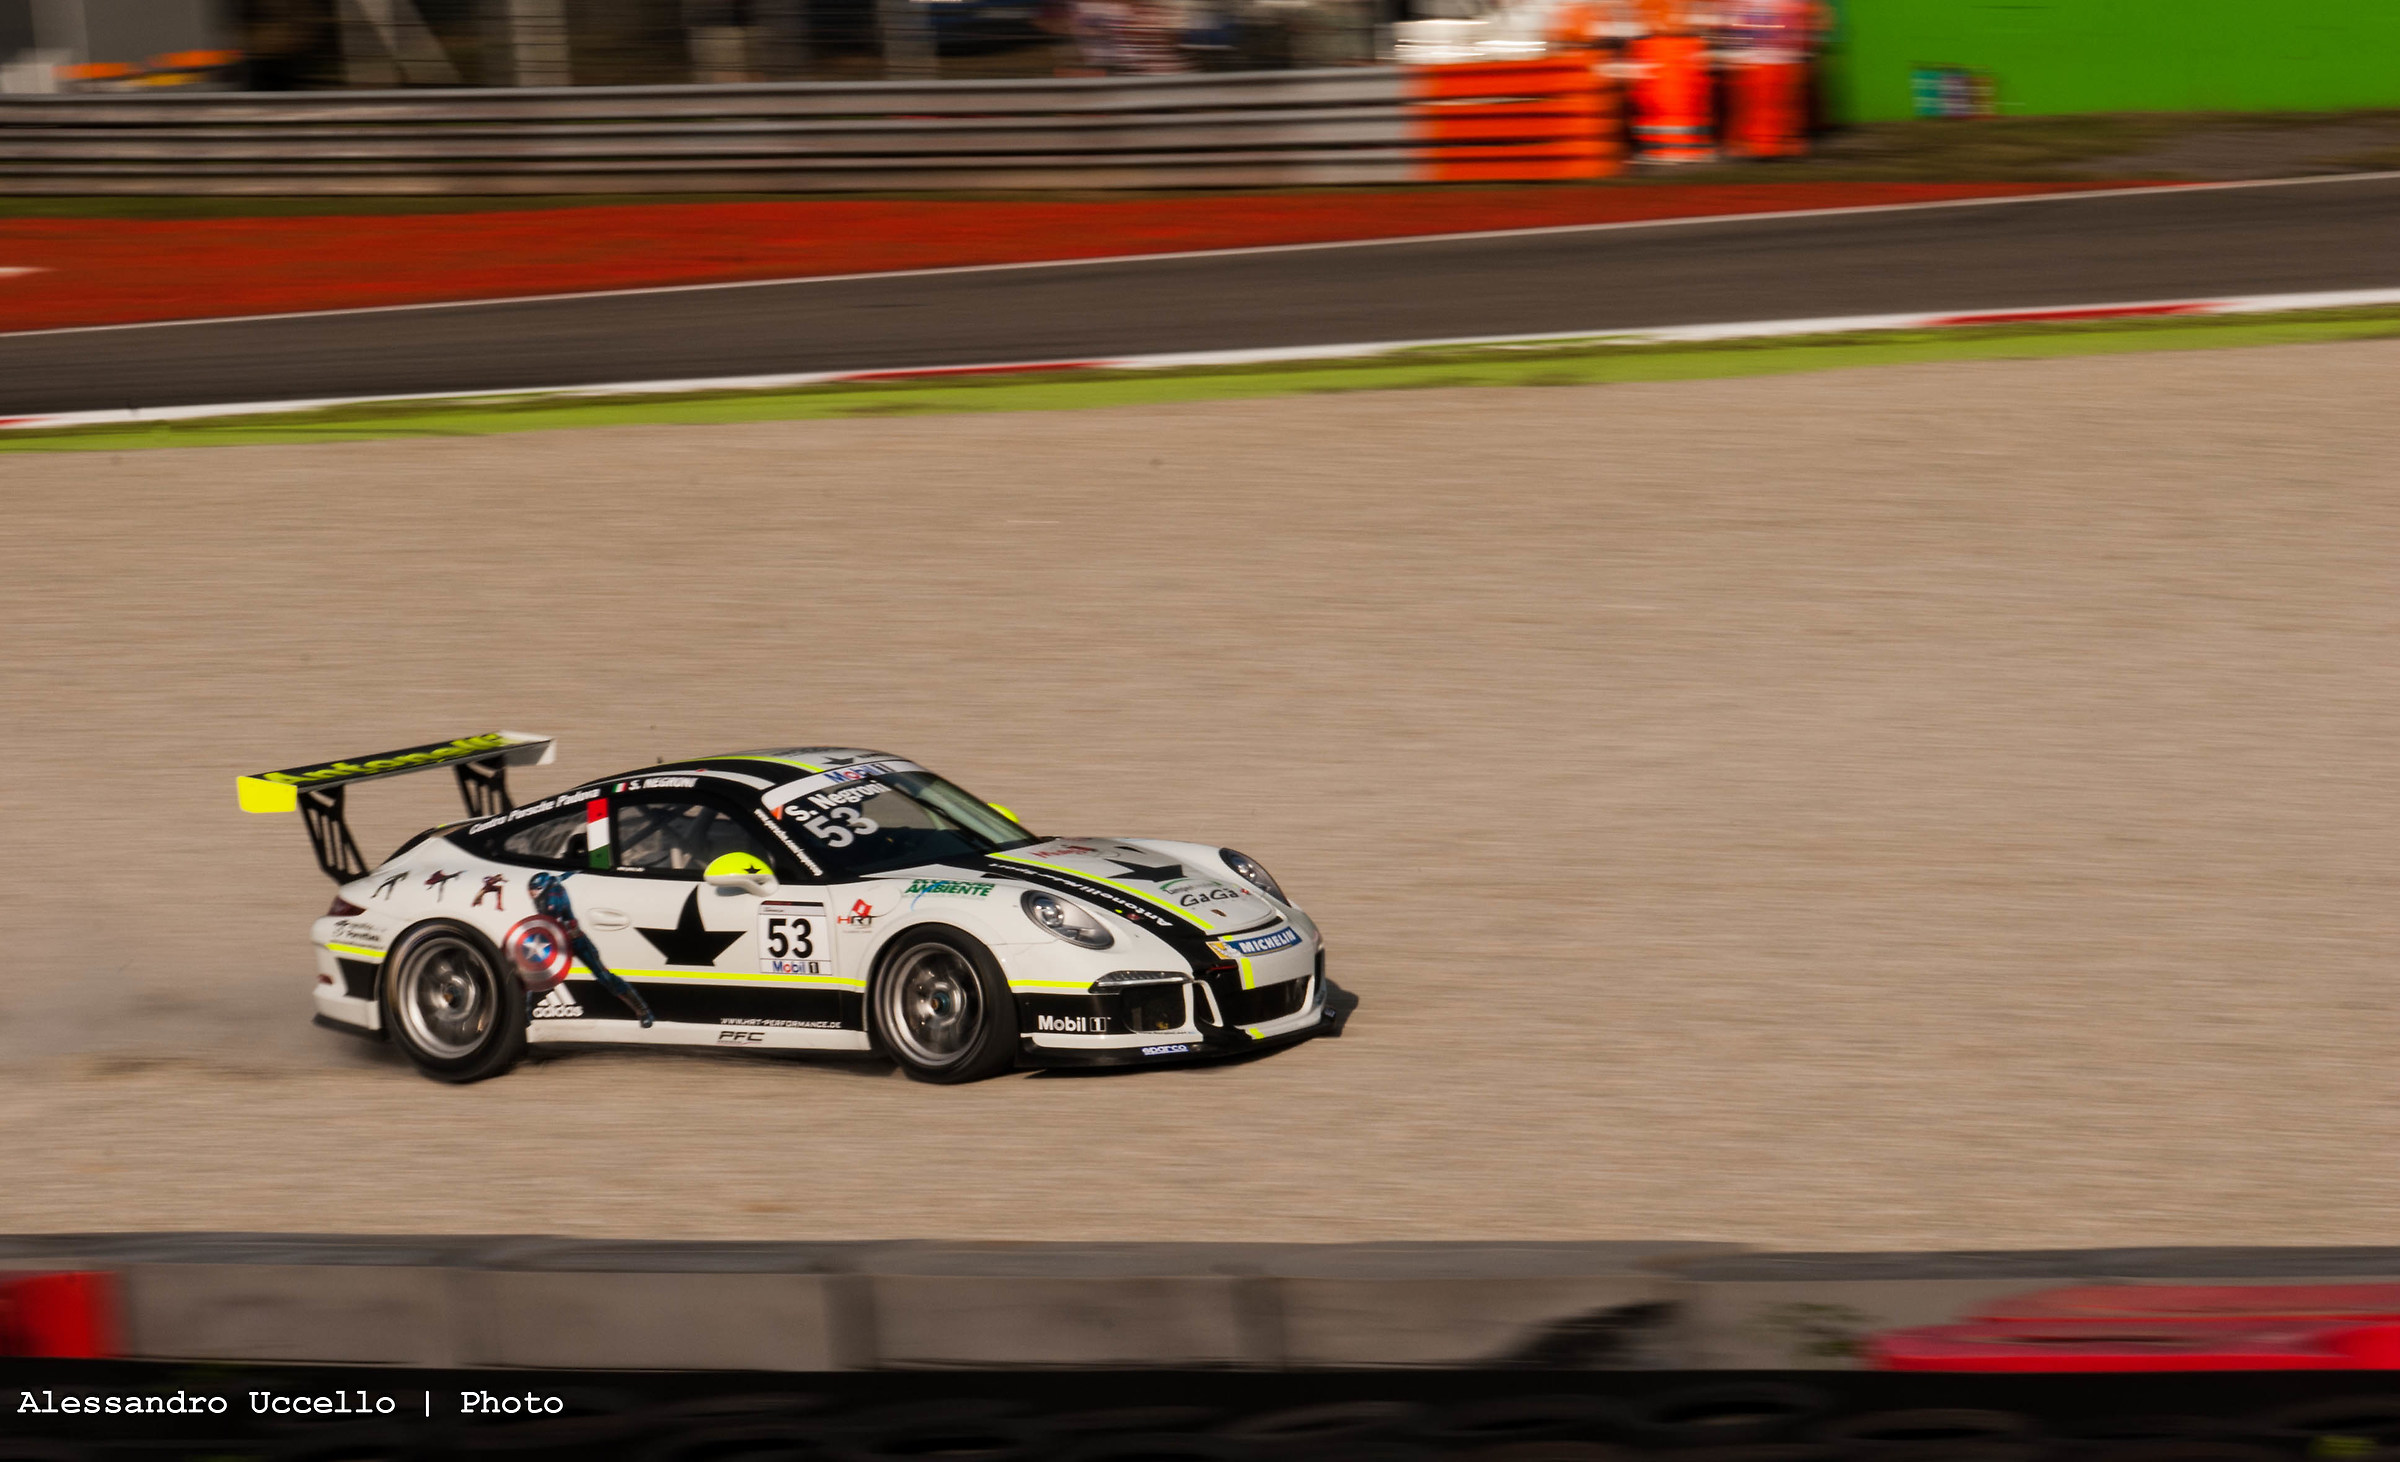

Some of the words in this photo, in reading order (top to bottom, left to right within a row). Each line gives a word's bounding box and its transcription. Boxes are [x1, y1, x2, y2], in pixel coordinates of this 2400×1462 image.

[823, 764, 881, 784] Mobil
[627, 778, 642, 791] S.
[642, 776, 699, 789] NEGRONI
[784, 805, 819, 822] S.
[807, 779, 893, 810] Negroni
[507, 799, 555, 822] Porsche
[802, 806, 880, 848] 53
[904, 882, 993, 897] AMBIENTE
[837, 915, 874, 926] HRT
[767, 917, 814, 959] 53
[1238, 928, 1297, 953] MICHELIN
[772, 960, 806, 974] Mobil
[808, 960, 820, 974] 1
[532, 1004, 584, 1018] adidas
[1037, 1014, 1086, 1032] Mobil
[1089, 1016, 1107, 1033] 1
[718, 1030, 765, 1042] PFC
[1141, 1044, 1188, 1056] sparco
